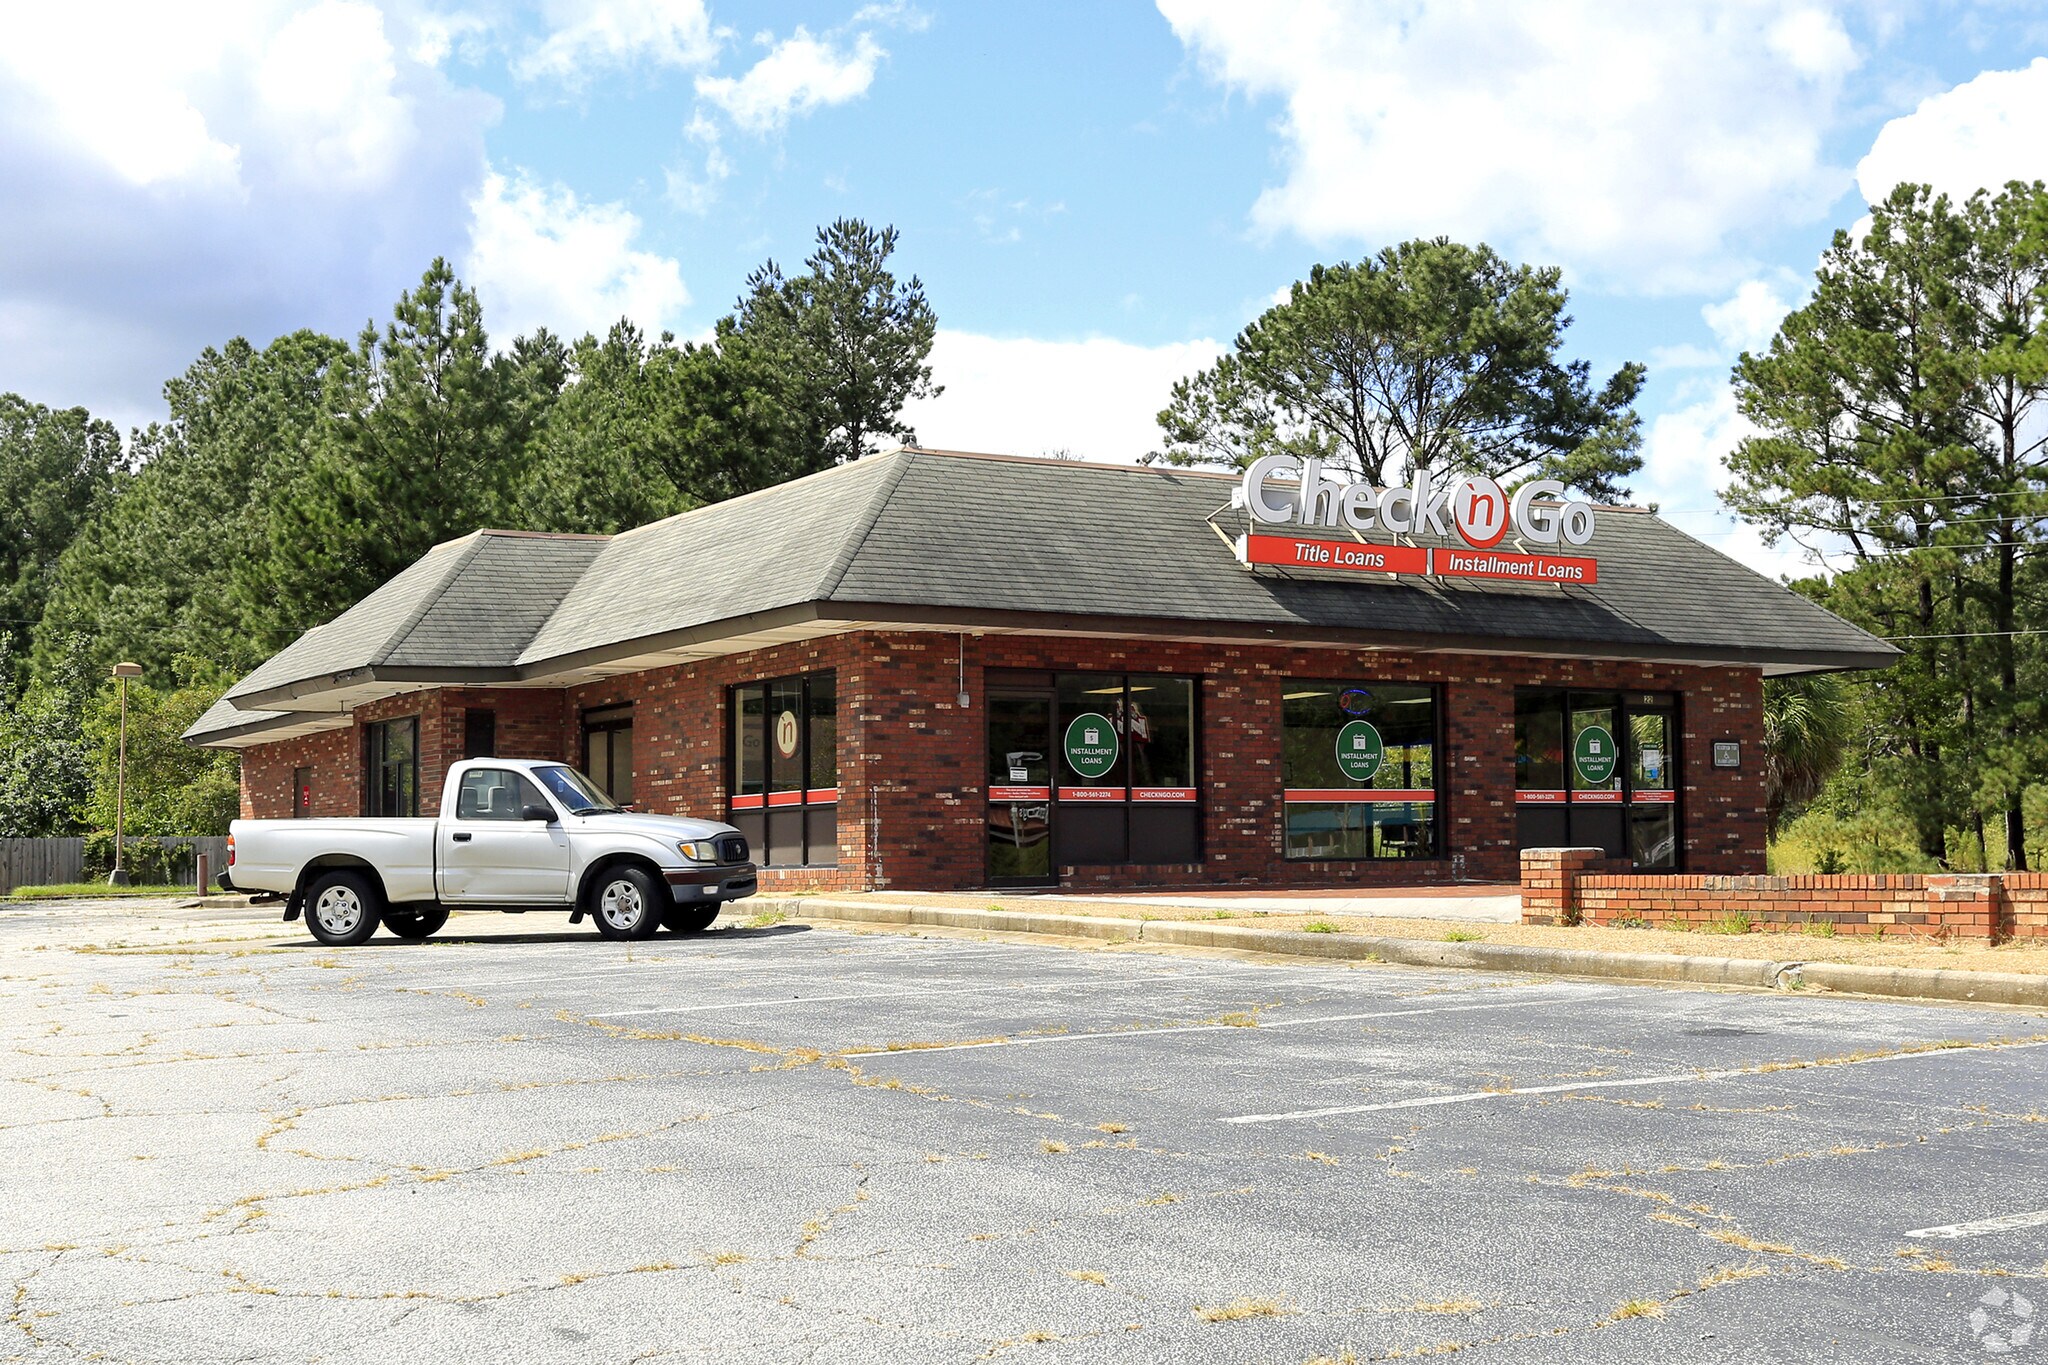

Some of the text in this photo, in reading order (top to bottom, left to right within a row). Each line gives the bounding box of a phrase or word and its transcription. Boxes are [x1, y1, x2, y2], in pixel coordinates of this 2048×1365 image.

[1242, 454, 1449, 536] Check
[1512, 479, 1596, 546] Go
[1294, 543, 1385, 567] Title Loans
[1449, 553, 1583, 579] Installment Loans
